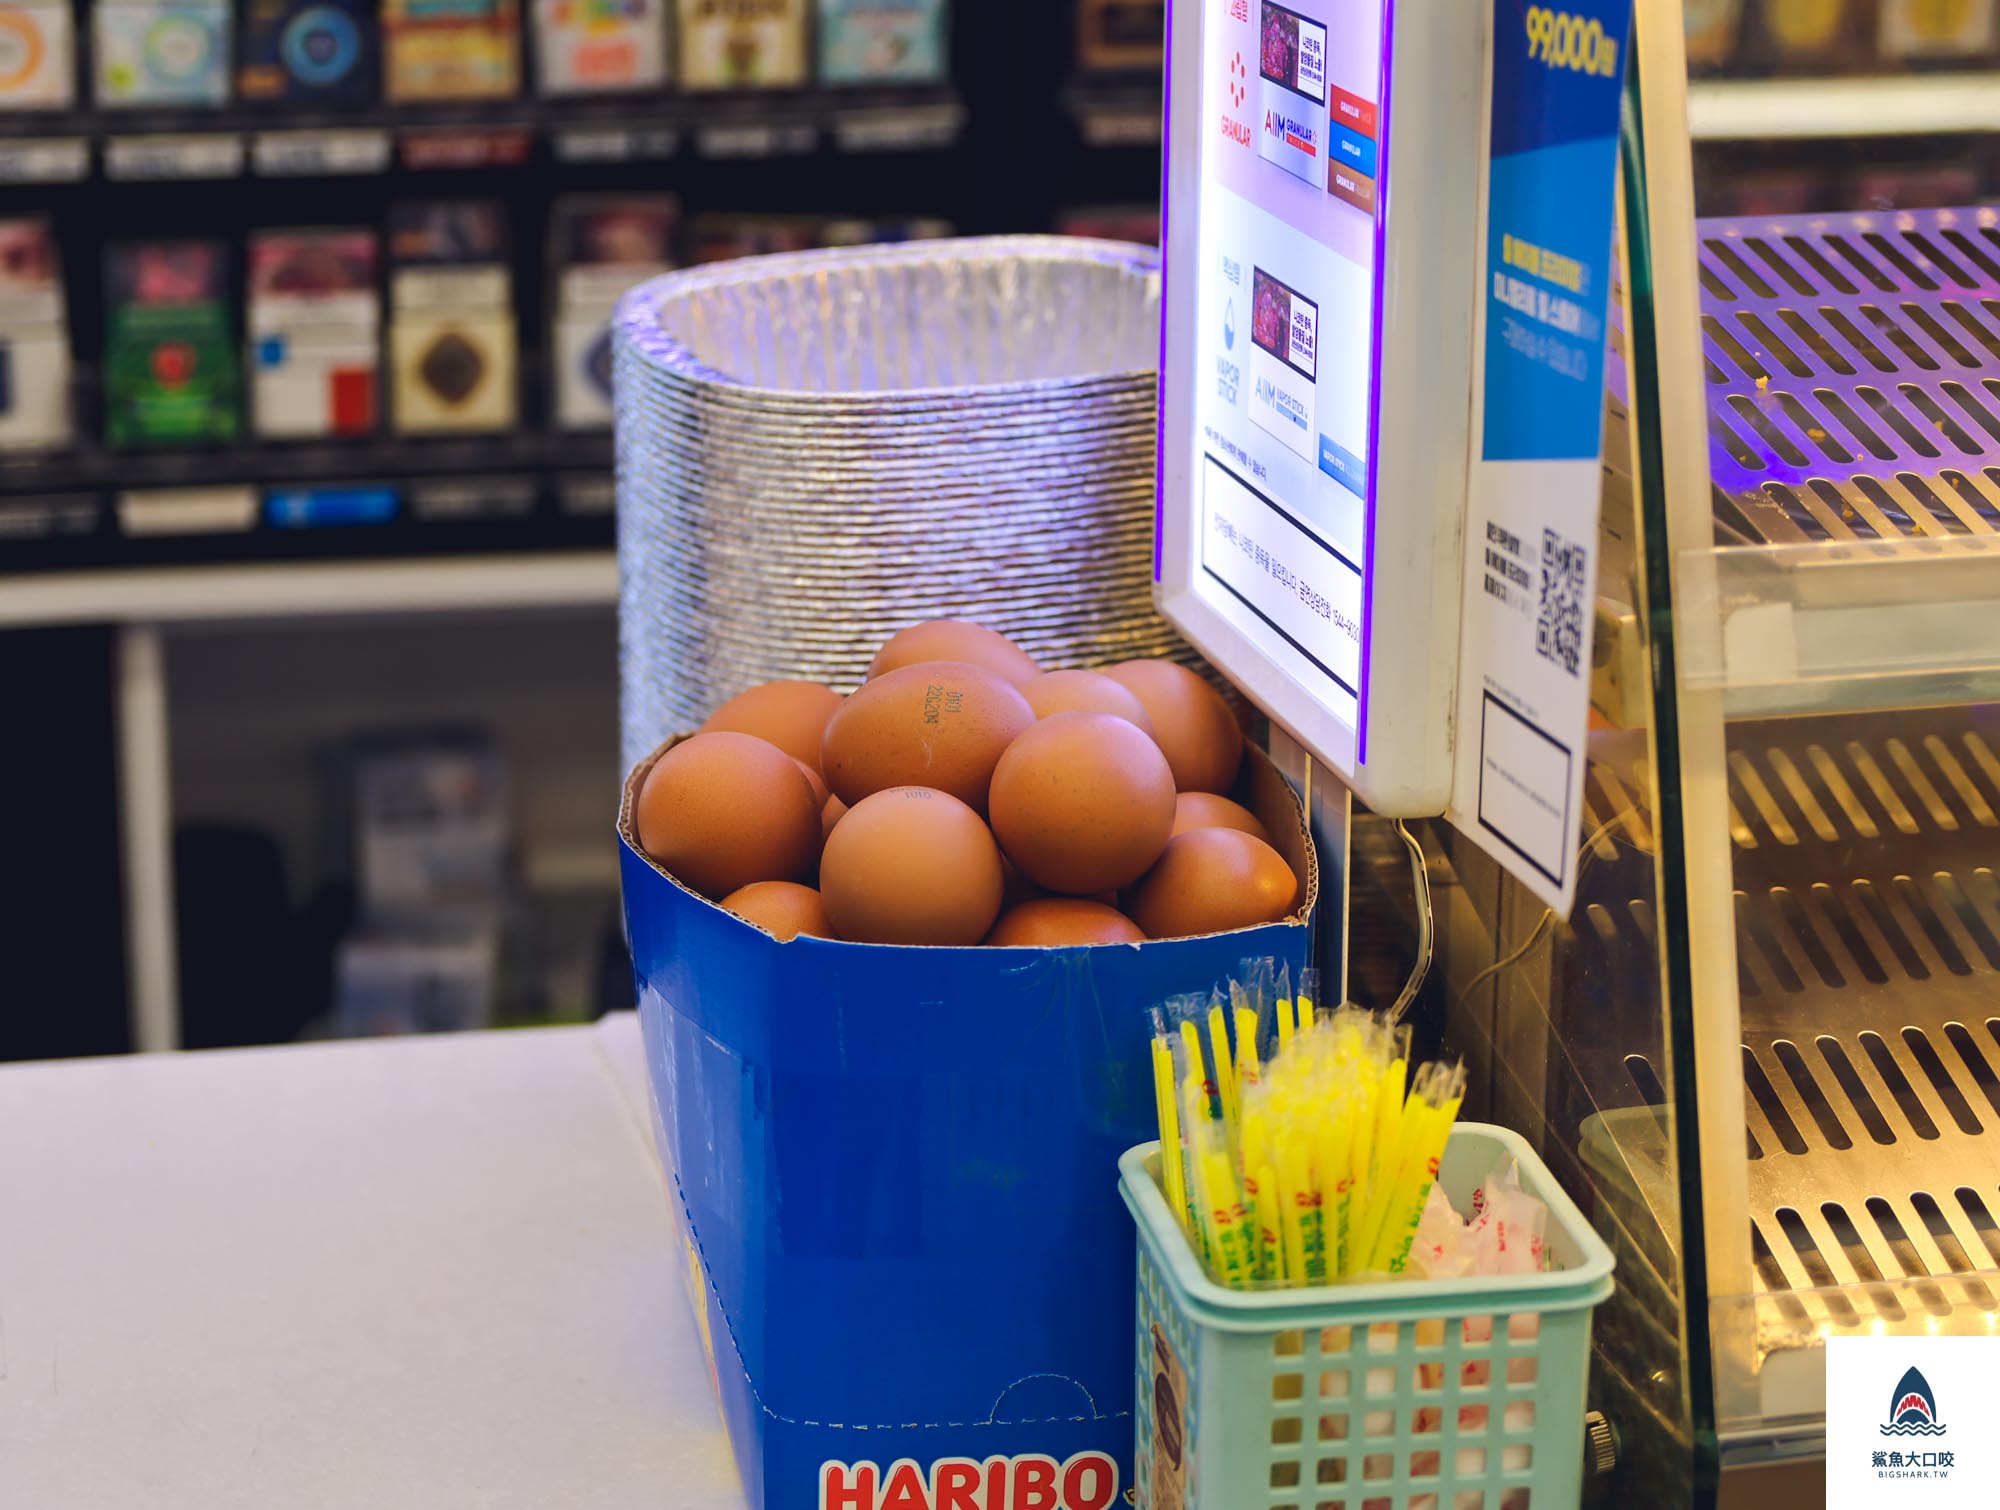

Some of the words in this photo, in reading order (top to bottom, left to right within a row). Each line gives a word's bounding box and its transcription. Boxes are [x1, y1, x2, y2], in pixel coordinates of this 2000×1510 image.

[1220, 114, 1251, 149] GRANULAR
[1286, 118, 1312, 142] GRANULAR
[1216, 355, 1240, 388] VAPOR
[1218, 376, 1238, 408] STICK
[1254, 543, 1270, 573] 중독을
[1271, 557, 1298, 596] 일으킵니다.
[1299, 579, 1331, 624] 금연상담전화
[821, 1453, 1117, 1510] HARIBO
